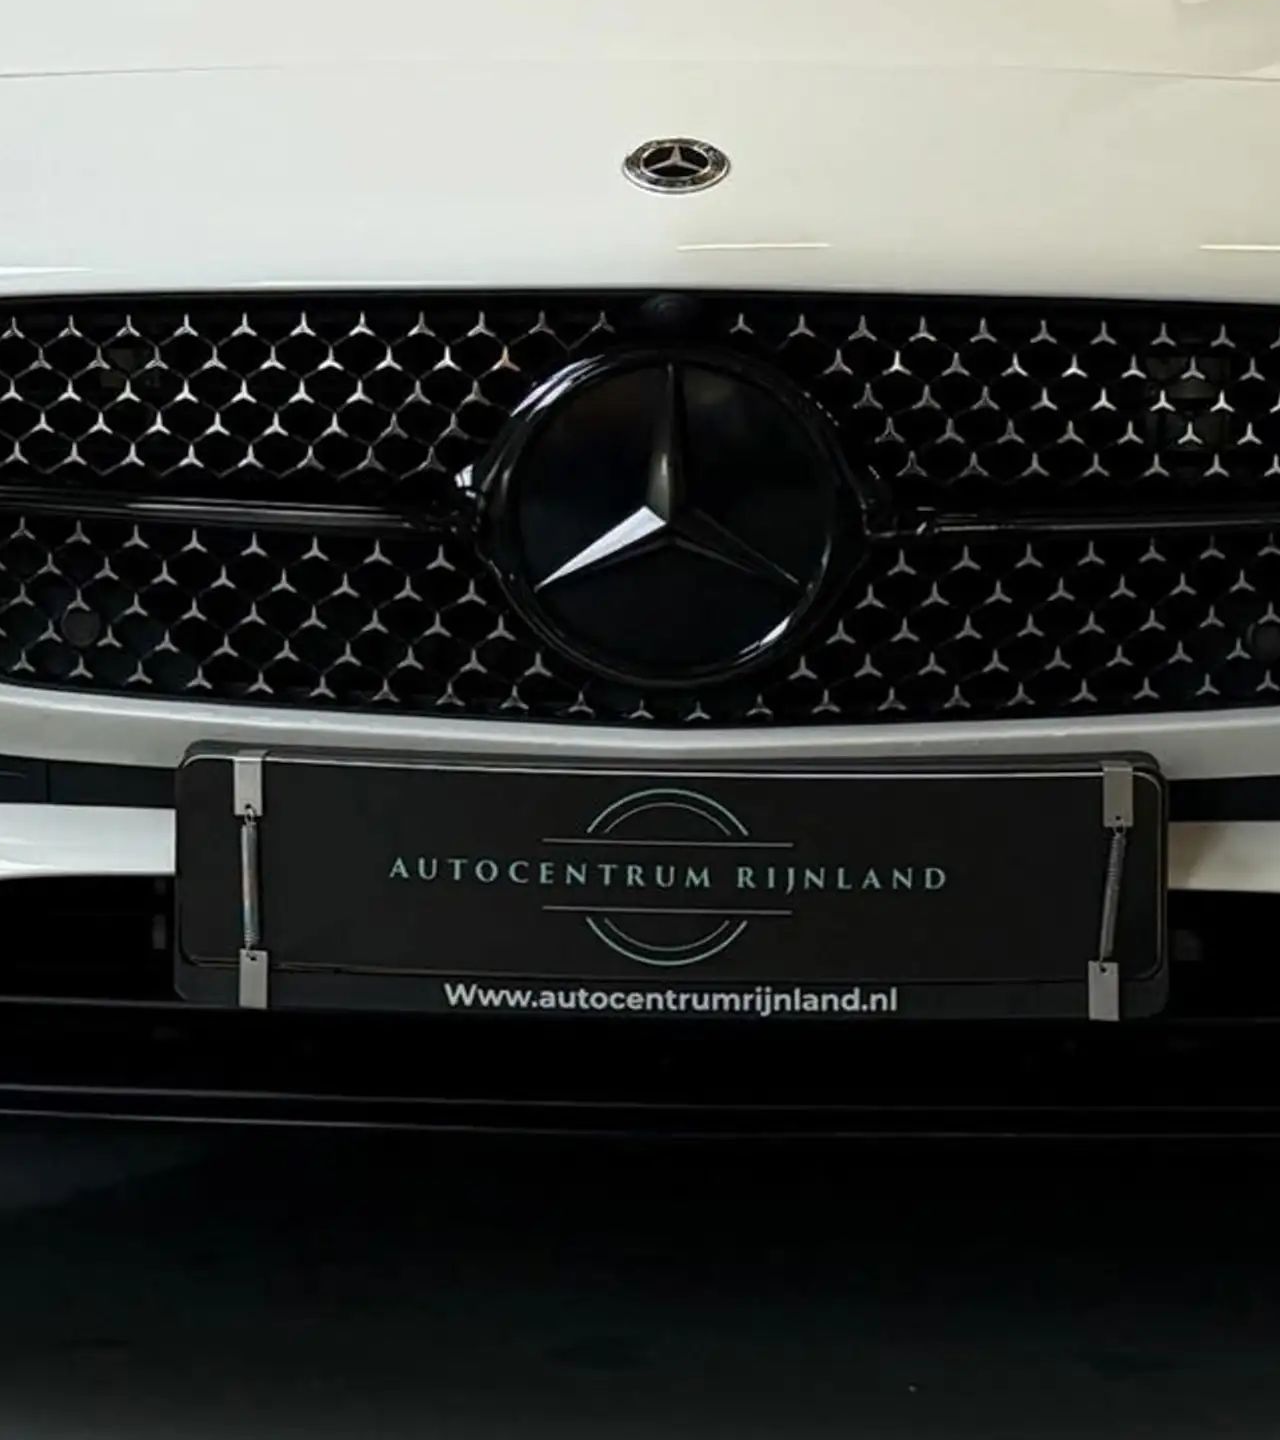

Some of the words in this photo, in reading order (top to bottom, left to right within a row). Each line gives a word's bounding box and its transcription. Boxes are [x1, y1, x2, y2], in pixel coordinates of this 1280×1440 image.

[389, 857, 711, 888] AUTOCENTRUM
[736, 866, 947, 894] RIJNLAND
[443, 982, 898, 1017] Www.autocentrumrijnland.nl
